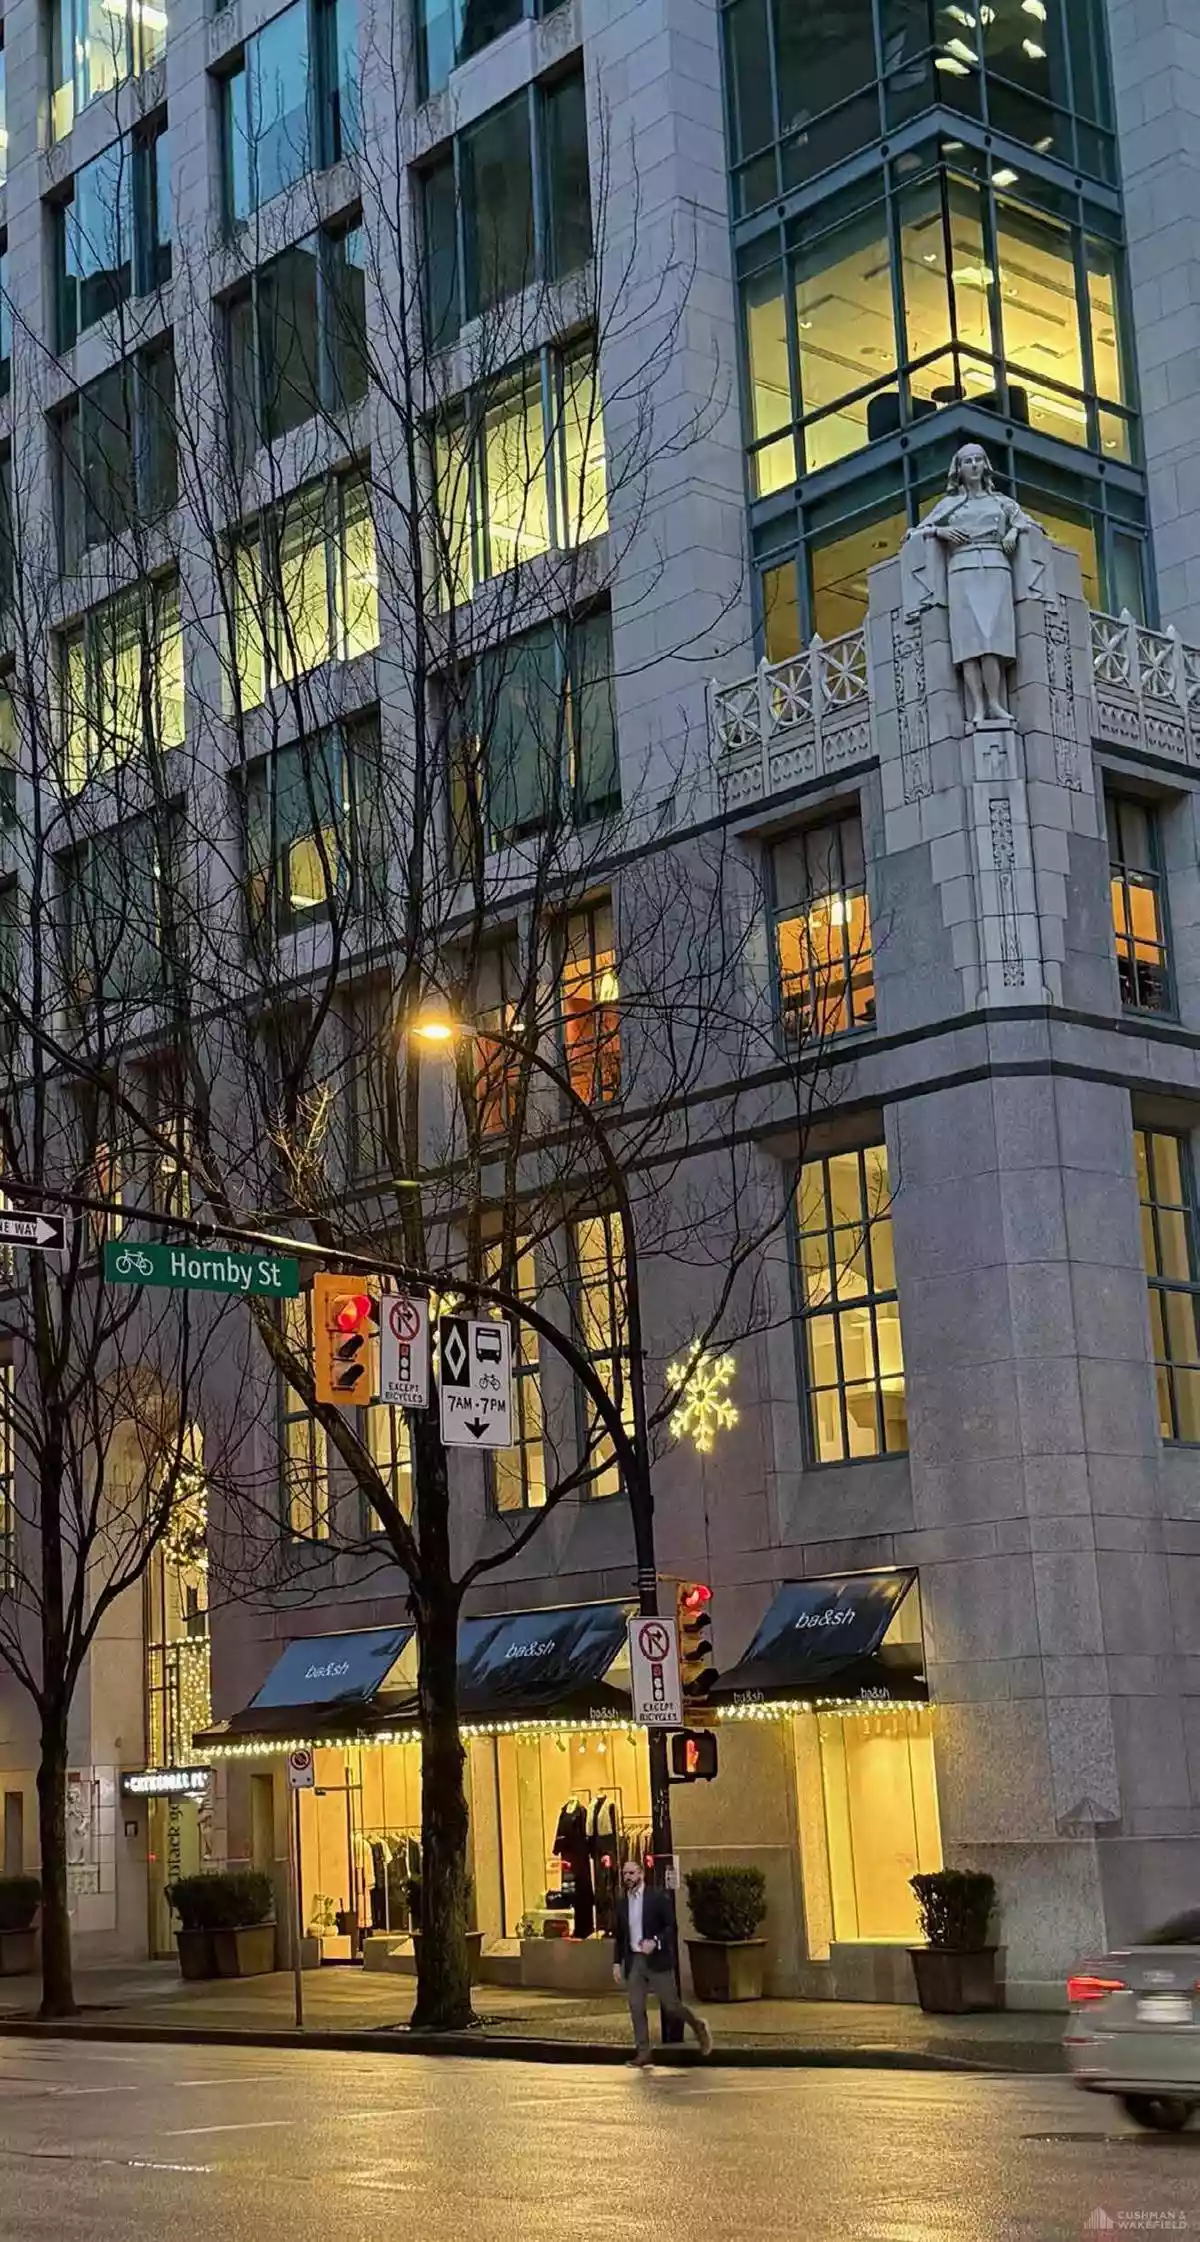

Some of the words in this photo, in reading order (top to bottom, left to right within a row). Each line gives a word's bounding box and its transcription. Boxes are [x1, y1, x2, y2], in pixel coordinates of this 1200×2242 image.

[14, 1222, 37, 1236] WAY
[171, 1252, 252, 1290] Hornby
[258, 1260, 282, 1287] St
[388, 1381, 419, 1392] EXCEPT
[385, 1391, 423, 1403] BICYCLES
[447, 1395, 473, 1412] 7AM
[480, 1397, 506, 1414] 7PM
[795, 1607, 856, 1629] ba&sh
[504, 1639, 556, 1658] ba&sh
[859, 1686, 890, 1699] ba&sh
[589, 1706, 619, 1719] ba&sh
[643, 1702, 675, 1712] EXCEPT
[639, 1712, 678, 1721] BICYCLES
